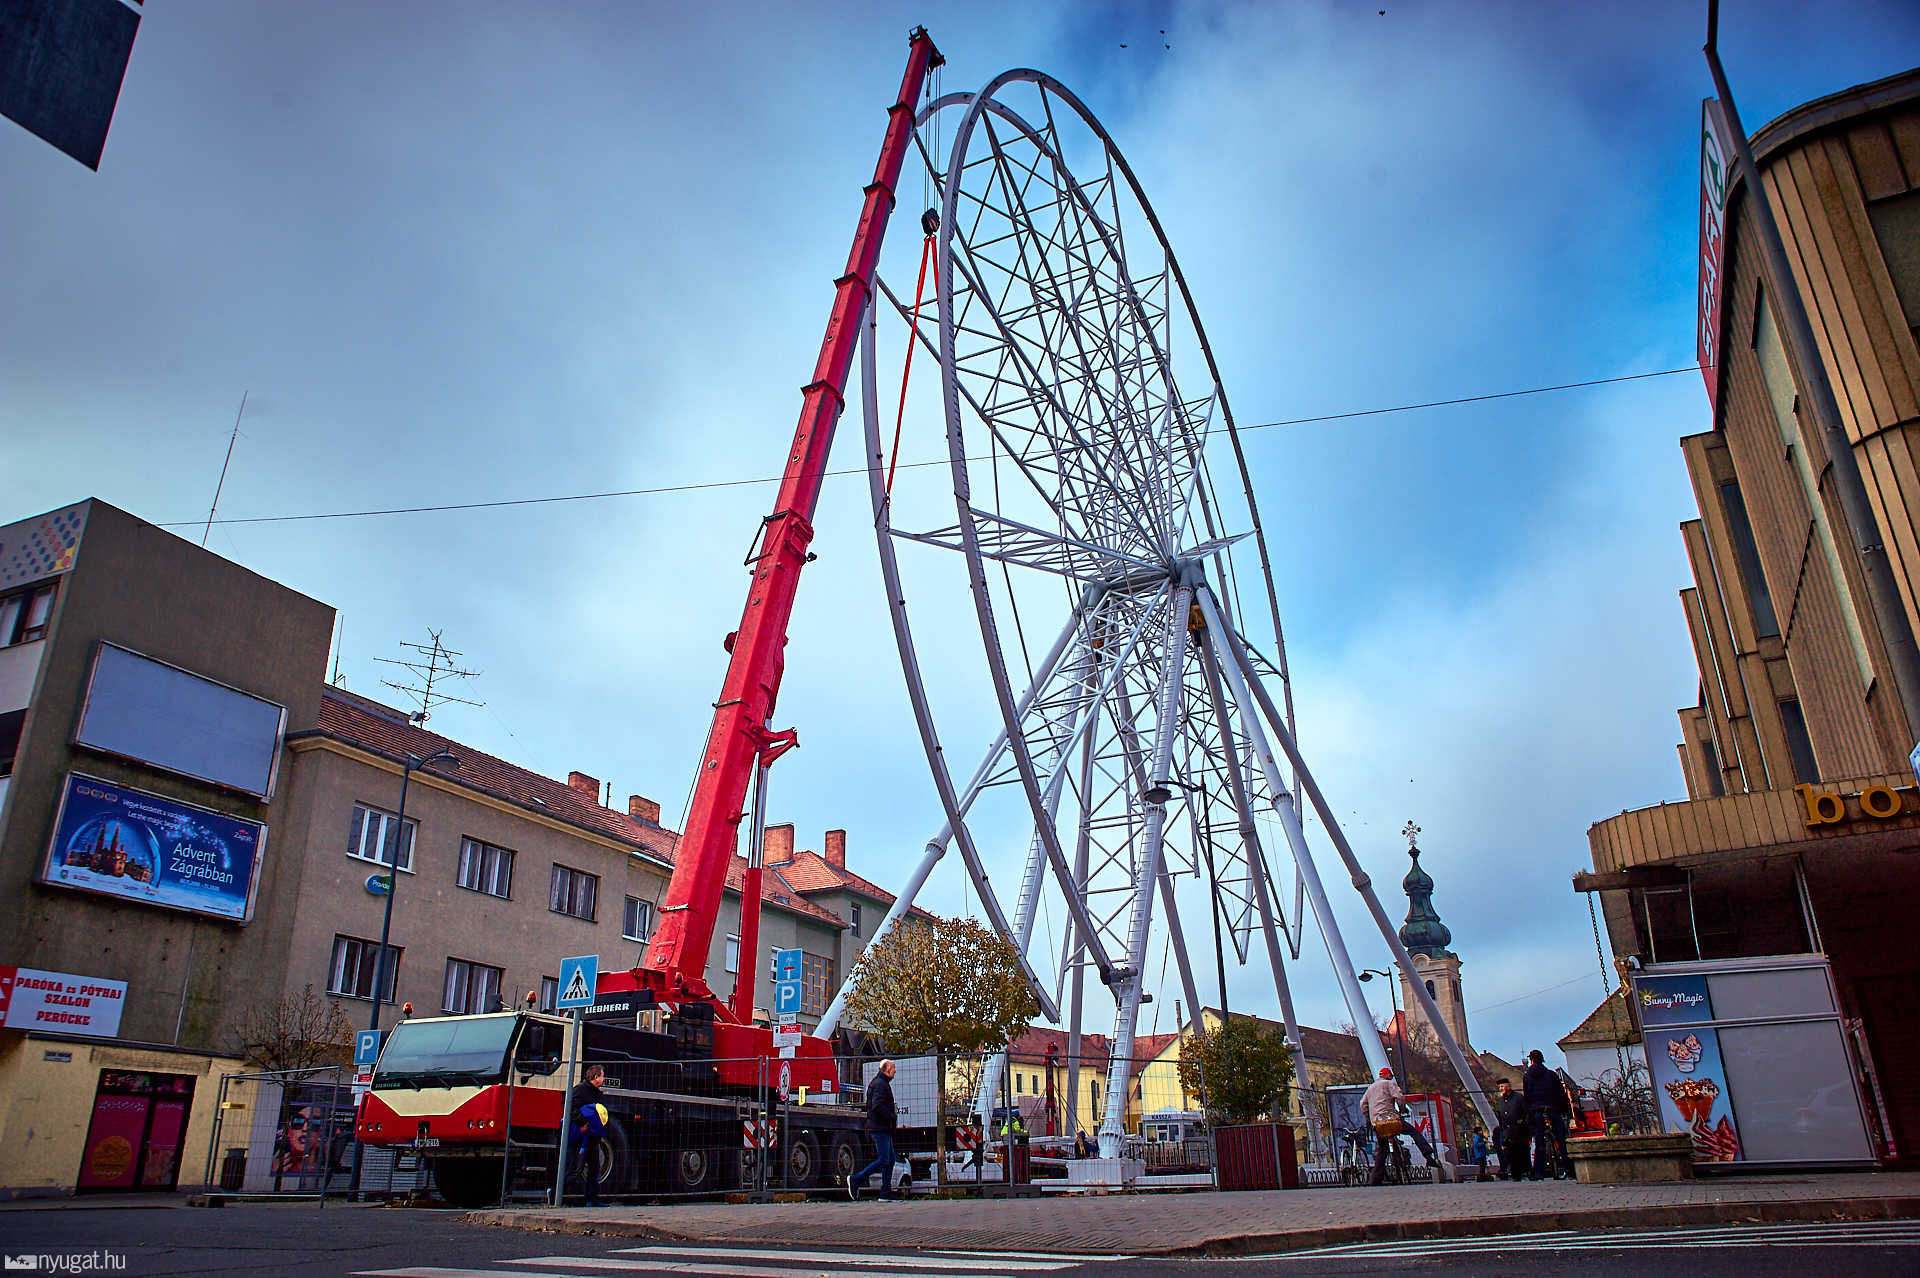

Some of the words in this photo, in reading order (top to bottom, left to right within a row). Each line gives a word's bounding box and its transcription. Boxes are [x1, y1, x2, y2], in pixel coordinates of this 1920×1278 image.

[1702, 200, 1719, 370] SPAR
[1794, 782, 1919, 825] bo
[173, 842, 216, 863] Advent
[170, 857, 233, 884] Zágrábban
[16, 977, 63, 992] PARÓKA
[80, 983, 123, 999] PÓTHAJ
[781, 986, 795, 1010] P
[44, 994, 91, 1008] SZALON
[584, 1003, 630, 1014] LIEBHERR
[1644, 995, 1672, 1009] Sunny
[1673, 993, 1704, 1007] Magic
[36, 1011, 91, 1026] PERÜCKE
[360, 1035, 374, 1060] P
